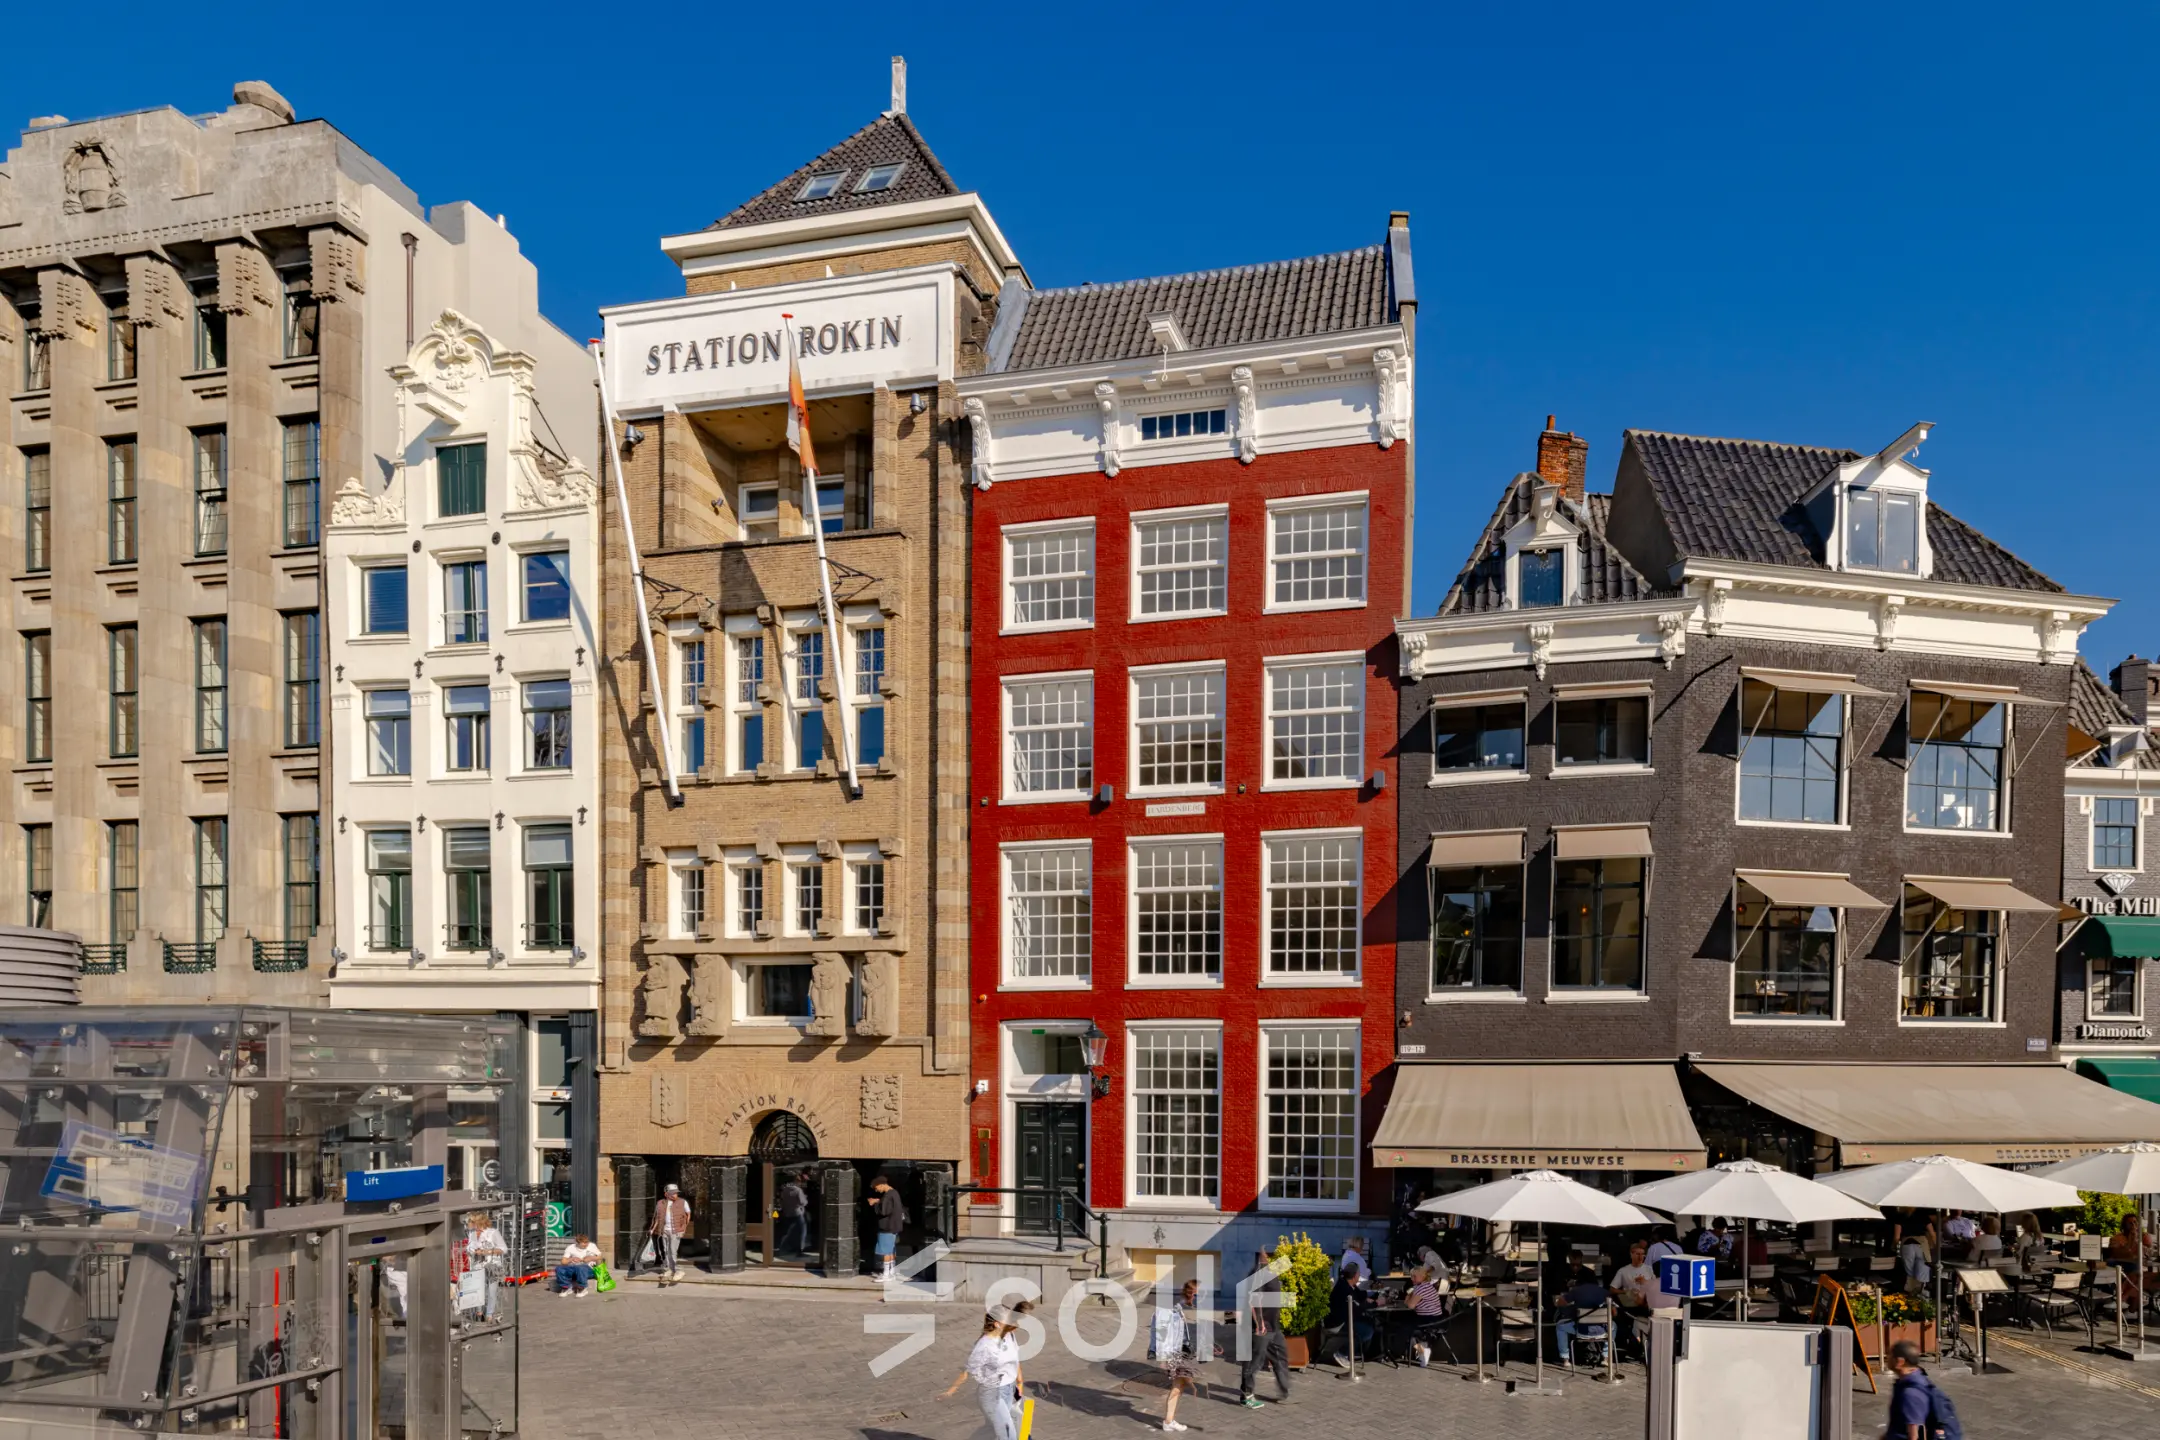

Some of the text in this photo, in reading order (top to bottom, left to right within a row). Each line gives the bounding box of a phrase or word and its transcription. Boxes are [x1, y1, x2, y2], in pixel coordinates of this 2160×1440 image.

[645, 315, 903, 376] STATION ROKIN
[2076, 896, 2117, 915] The
[2081, 1024, 2153, 1038] Diamonds
[720, 1094, 828, 1139] STATION ROKIN
[1450, 1154, 1625, 1166] BRASSERIE MEUWESE
[363, 1176, 380, 1186] Lift
